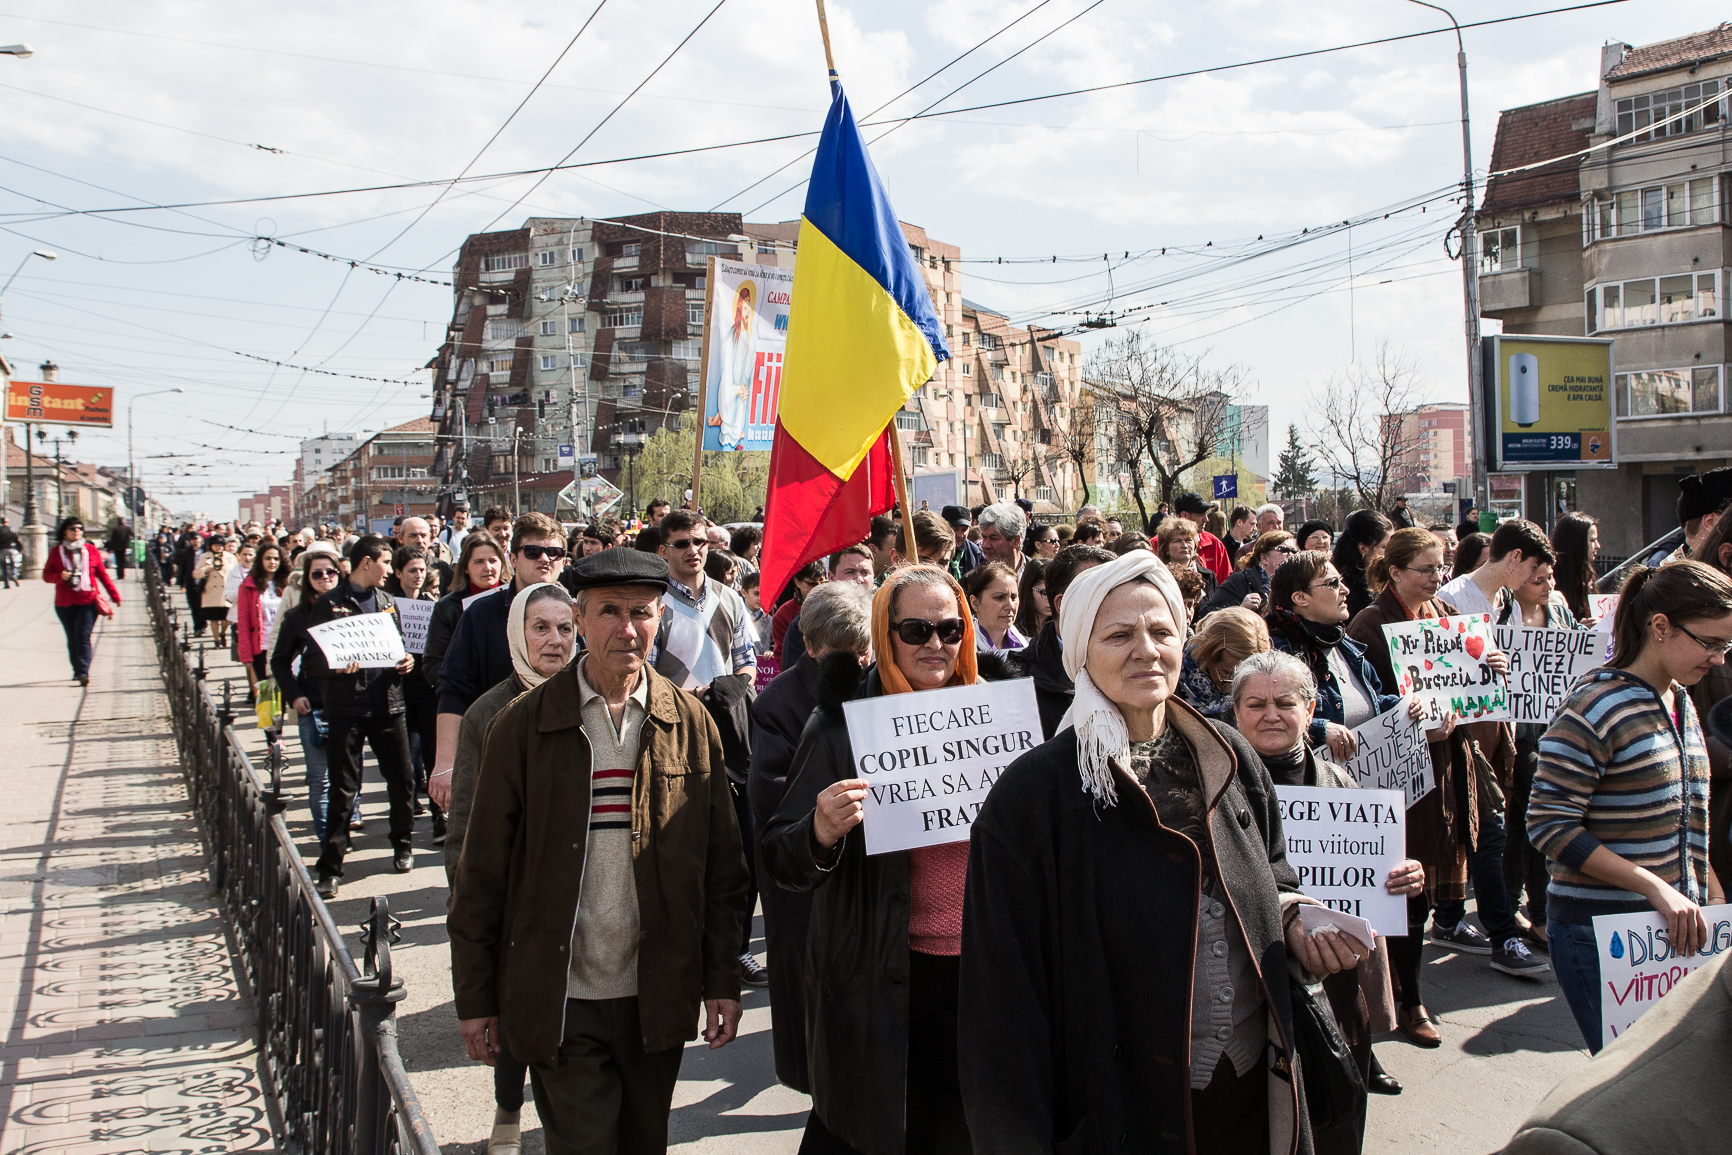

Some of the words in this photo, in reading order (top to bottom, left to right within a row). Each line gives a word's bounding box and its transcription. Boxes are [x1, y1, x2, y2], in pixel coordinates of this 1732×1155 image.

[749, 351, 782, 424] Fii
[1575, 376, 1587, 384] MAI
[1550, 435, 1572, 449] 339
[402, 613, 425, 621] minute
[332, 640, 392, 650] NEAMULUI
[1532, 653, 1575, 675] VEZI
[891, 704, 993, 737] FIECARE
[1382, 710, 1402, 739] SE
[859, 745, 938, 775] COPIL
[943, 730, 1035, 763] SINGUR
[869, 778, 937, 806] VREA
[942, 772, 973, 795] SA
[1327, 801, 1398, 830] VIAȚA
[1288, 835, 1312, 854] tru
[1318, 833, 1385, 856] viitorul
[1297, 866, 1377, 888] PIILOR
